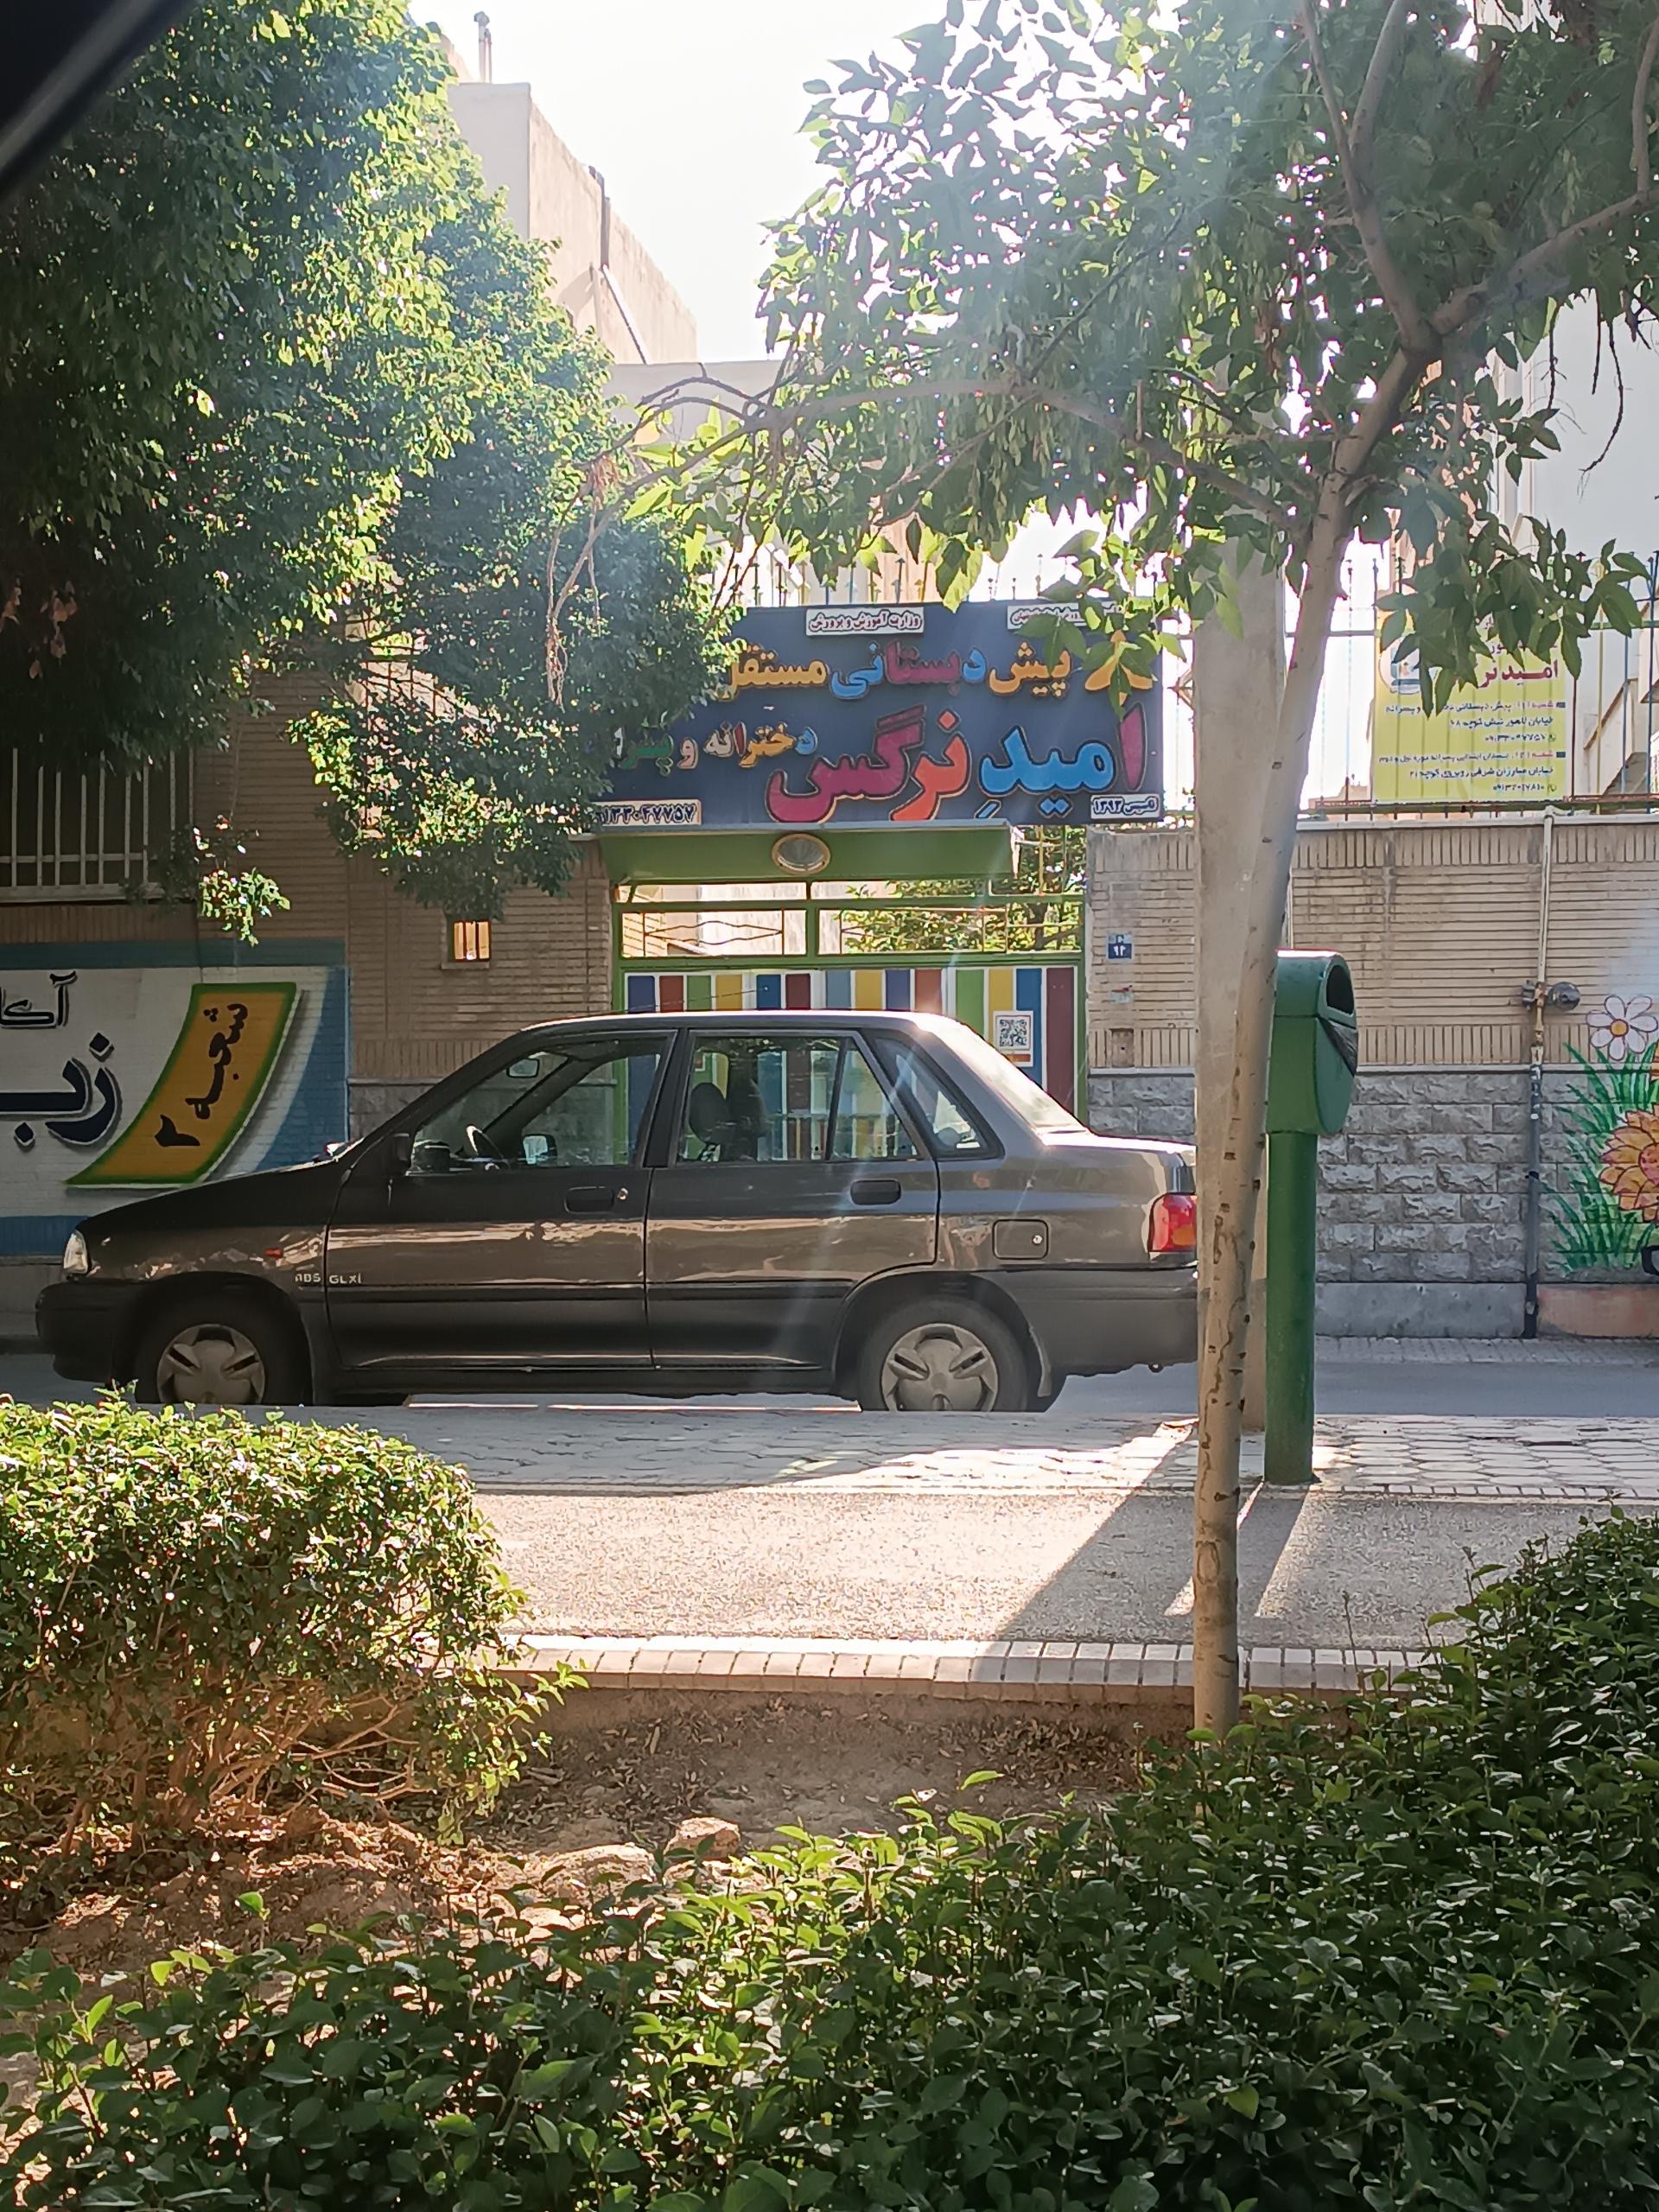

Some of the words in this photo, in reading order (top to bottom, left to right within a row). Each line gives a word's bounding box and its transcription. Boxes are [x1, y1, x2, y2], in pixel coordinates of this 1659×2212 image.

[809, 612, 844, 632] پرورش
[854, 609, 888, 630] آموزش
[888, 611, 922, 630] وزارت
[830, 639, 987, 699] دبستانی
[703, 721, 819, 769] دخترانه
[764, 702, 971, 823] نرگس
[184, 1002, 250, 1121] شعبه
